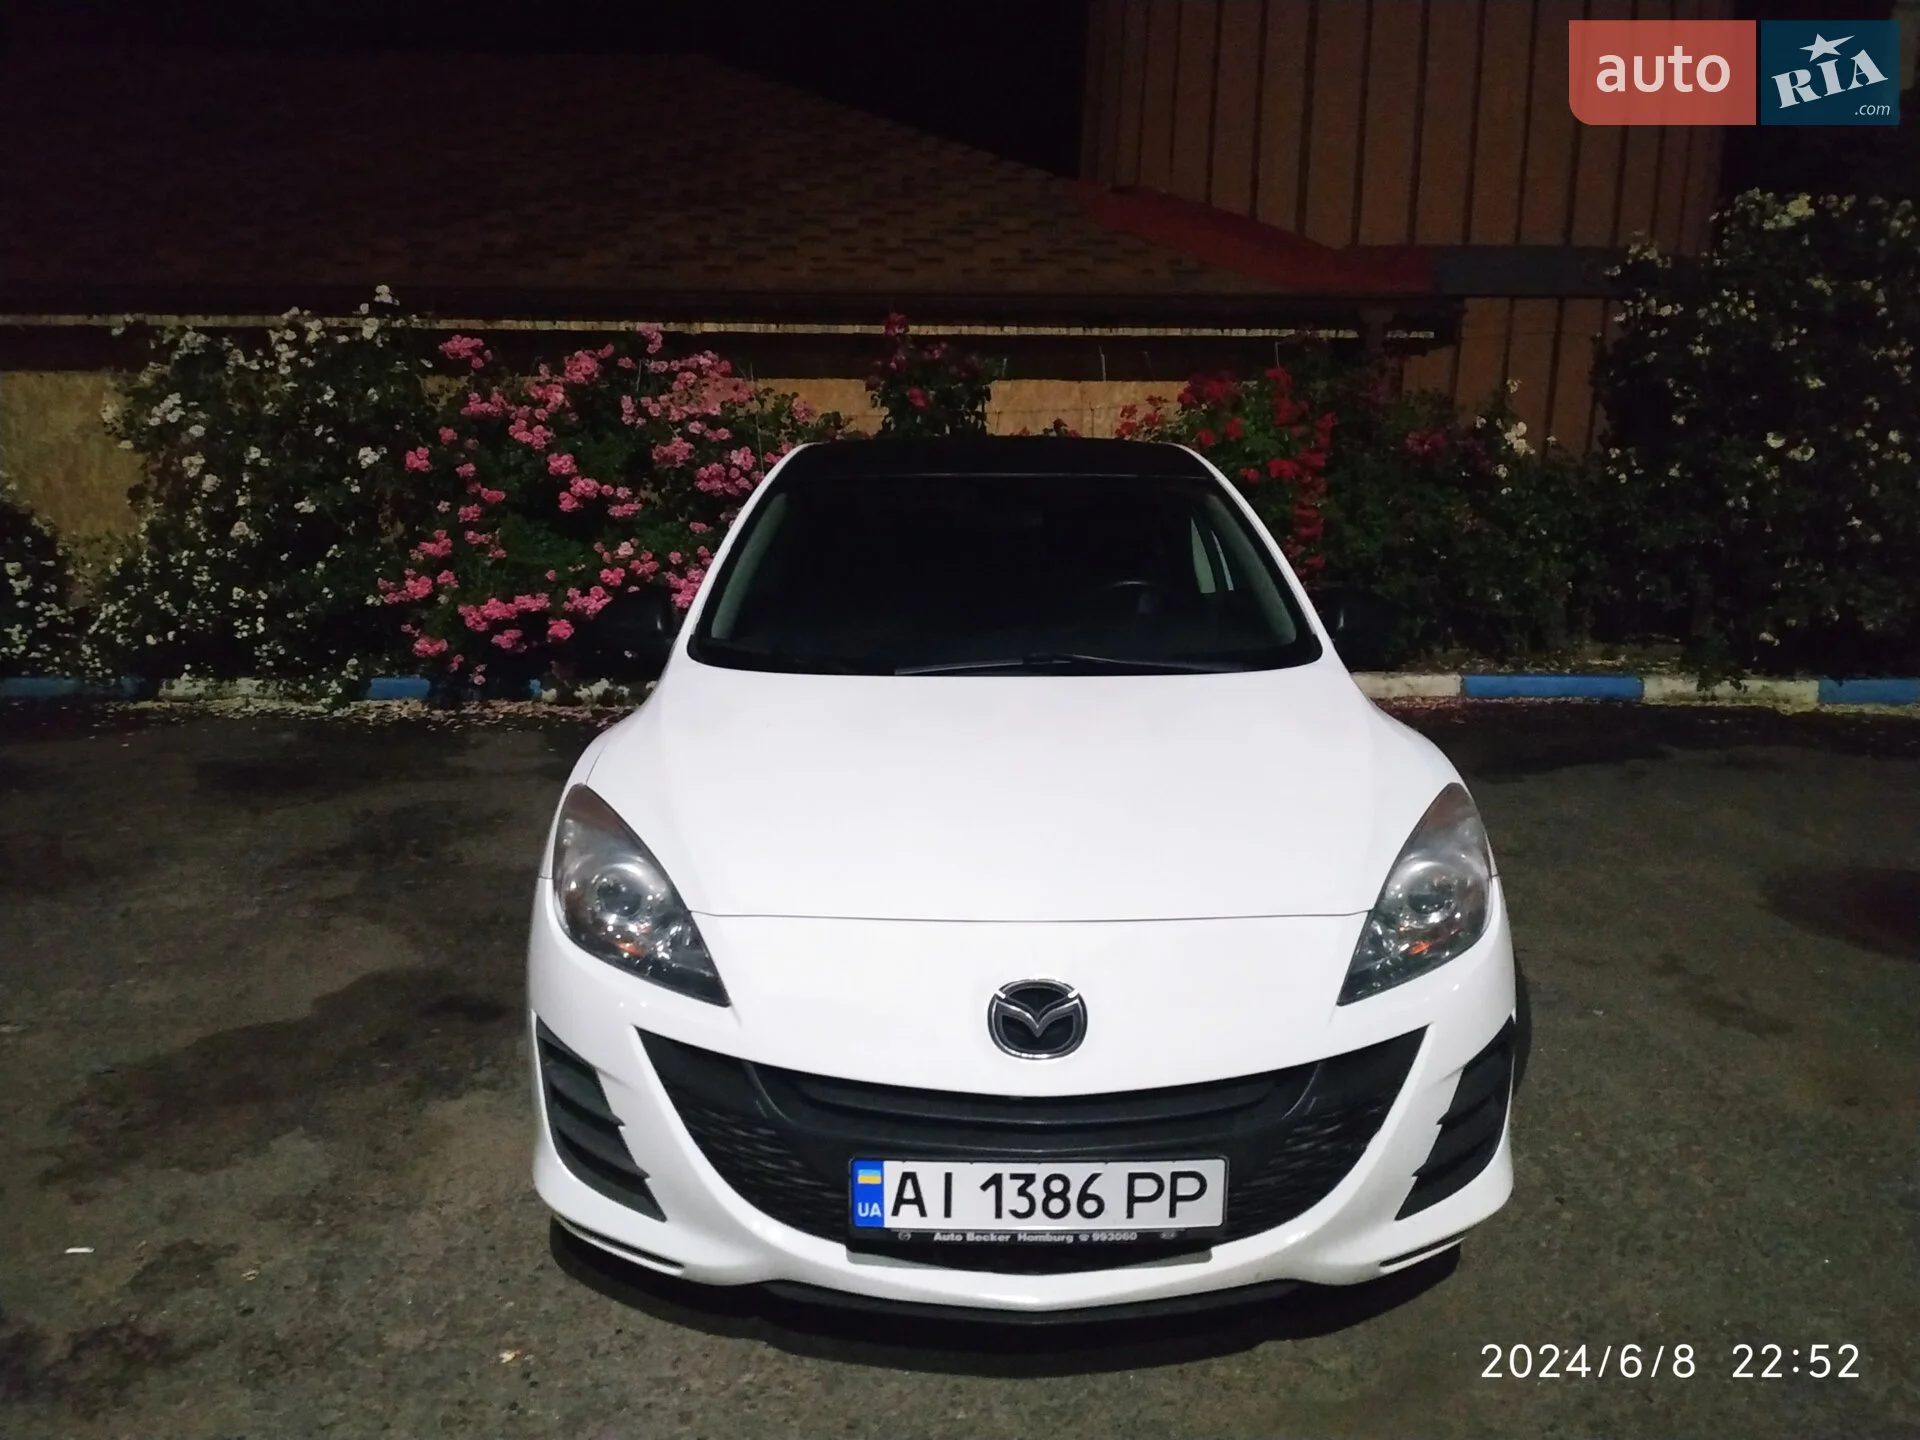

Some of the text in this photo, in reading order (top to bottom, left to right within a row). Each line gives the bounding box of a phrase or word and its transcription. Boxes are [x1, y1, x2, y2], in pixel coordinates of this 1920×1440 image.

[891, 1170, 1208, 1220] AI 1386 PP
[857, 1202, 882, 1218] UA
[933, 1232, 963, 1242] Auto
[966, 1232, 1011, 1242] Becker
[1017, 1232, 1074, 1244] Homburg
